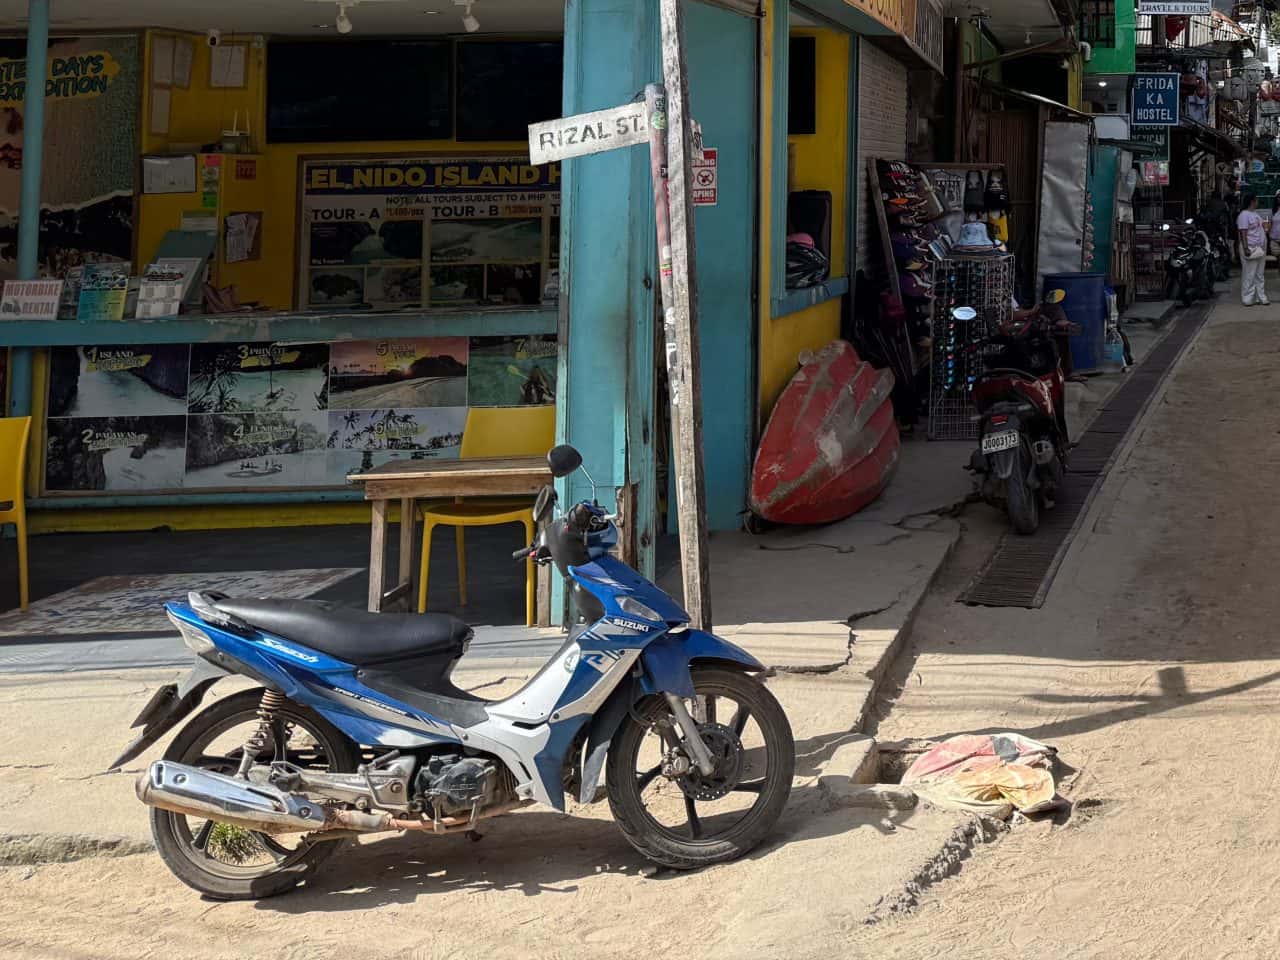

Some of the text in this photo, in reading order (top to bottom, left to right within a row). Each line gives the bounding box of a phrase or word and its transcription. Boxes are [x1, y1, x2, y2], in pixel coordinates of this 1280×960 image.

[1141, 4, 1171, 12] TRAVEL
[1183, 4, 1210, 12] TOURS
[1137, 77, 1175, 90] FRIDA
[1146, 92, 1164, 105] KA
[1137, 107, 1174, 121] HOSTEL
[538, 113, 646, 152] RIZAL ST.
[311, 167, 345, 189] EL
[353, 166, 427, 188] NIDO
[434, 165, 541, 186] ISLAND
[433, 195, 463, 203] TOURS
[464, 193, 504, 203] SUBJECT
[506, 193, 519, 201] TO
[312, 208, 355, 220] TOUR
[369, 208, 381, 219] A
[432, 205, 475, 217] TOUR
[489, 205, 499, 216] B
[100, 350, 135, 359] ISLAND
[613, 618, 649, 632] SUZUKI
[261, 638, 320, 663] Smash
